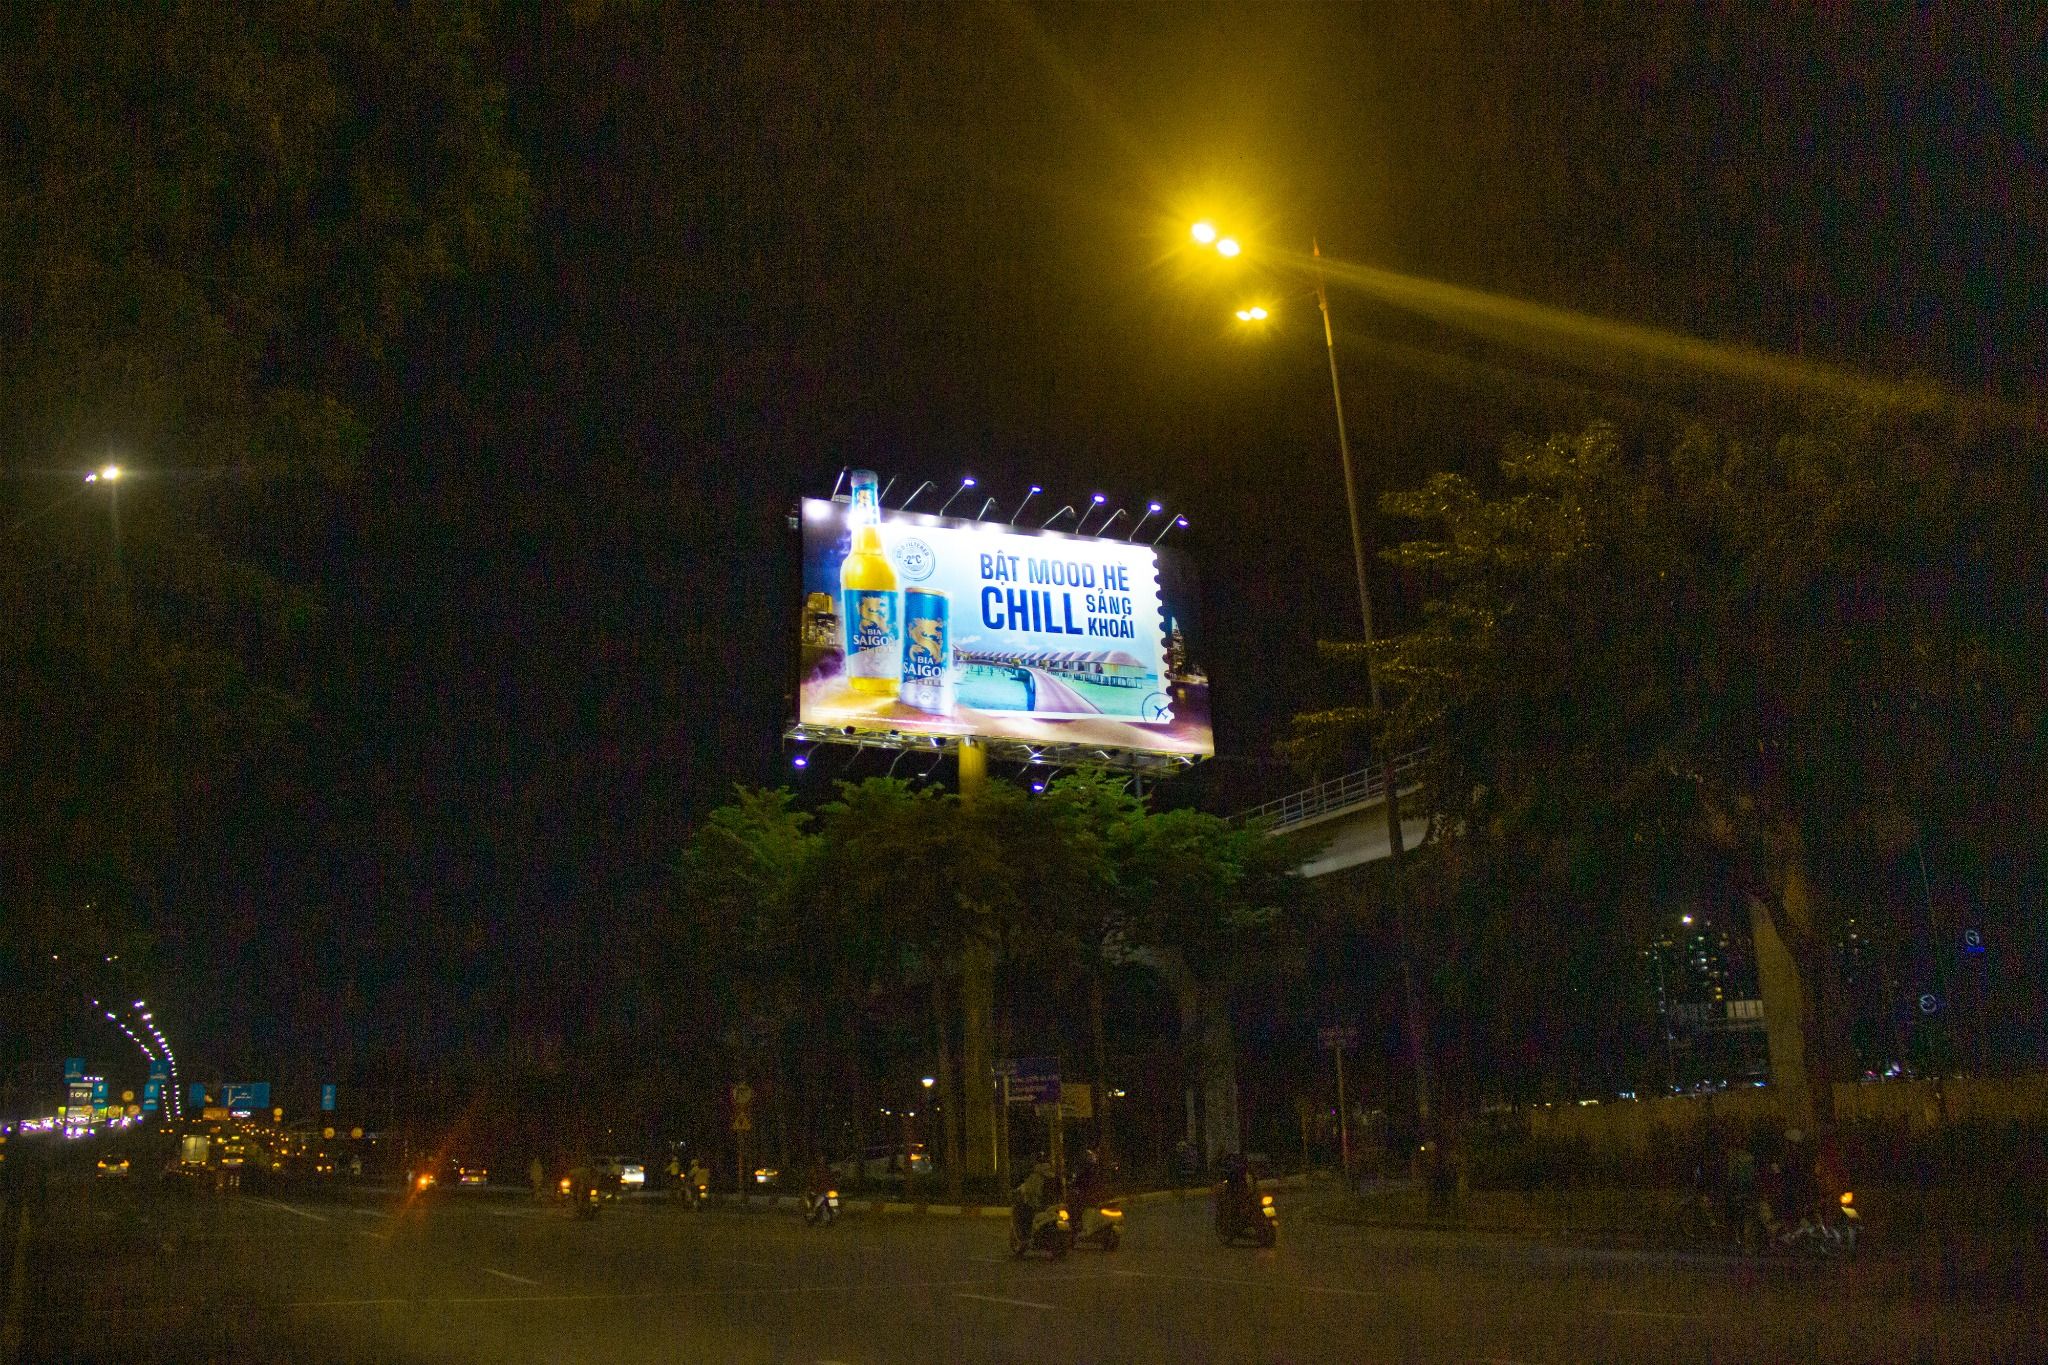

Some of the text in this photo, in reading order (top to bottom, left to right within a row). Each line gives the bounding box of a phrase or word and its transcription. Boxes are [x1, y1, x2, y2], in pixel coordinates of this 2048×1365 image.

[980, 550, 1131, 592] BẬT MOOD HÈ
[981, 585, 1084, 636] CHILL
[1085, 587, 1133, 616] SẢNG
[867, 628, 882, 636] BIA
[1087, 614, 1135, 639] KHOÁI
[917, 655, 934, 665] BIA
